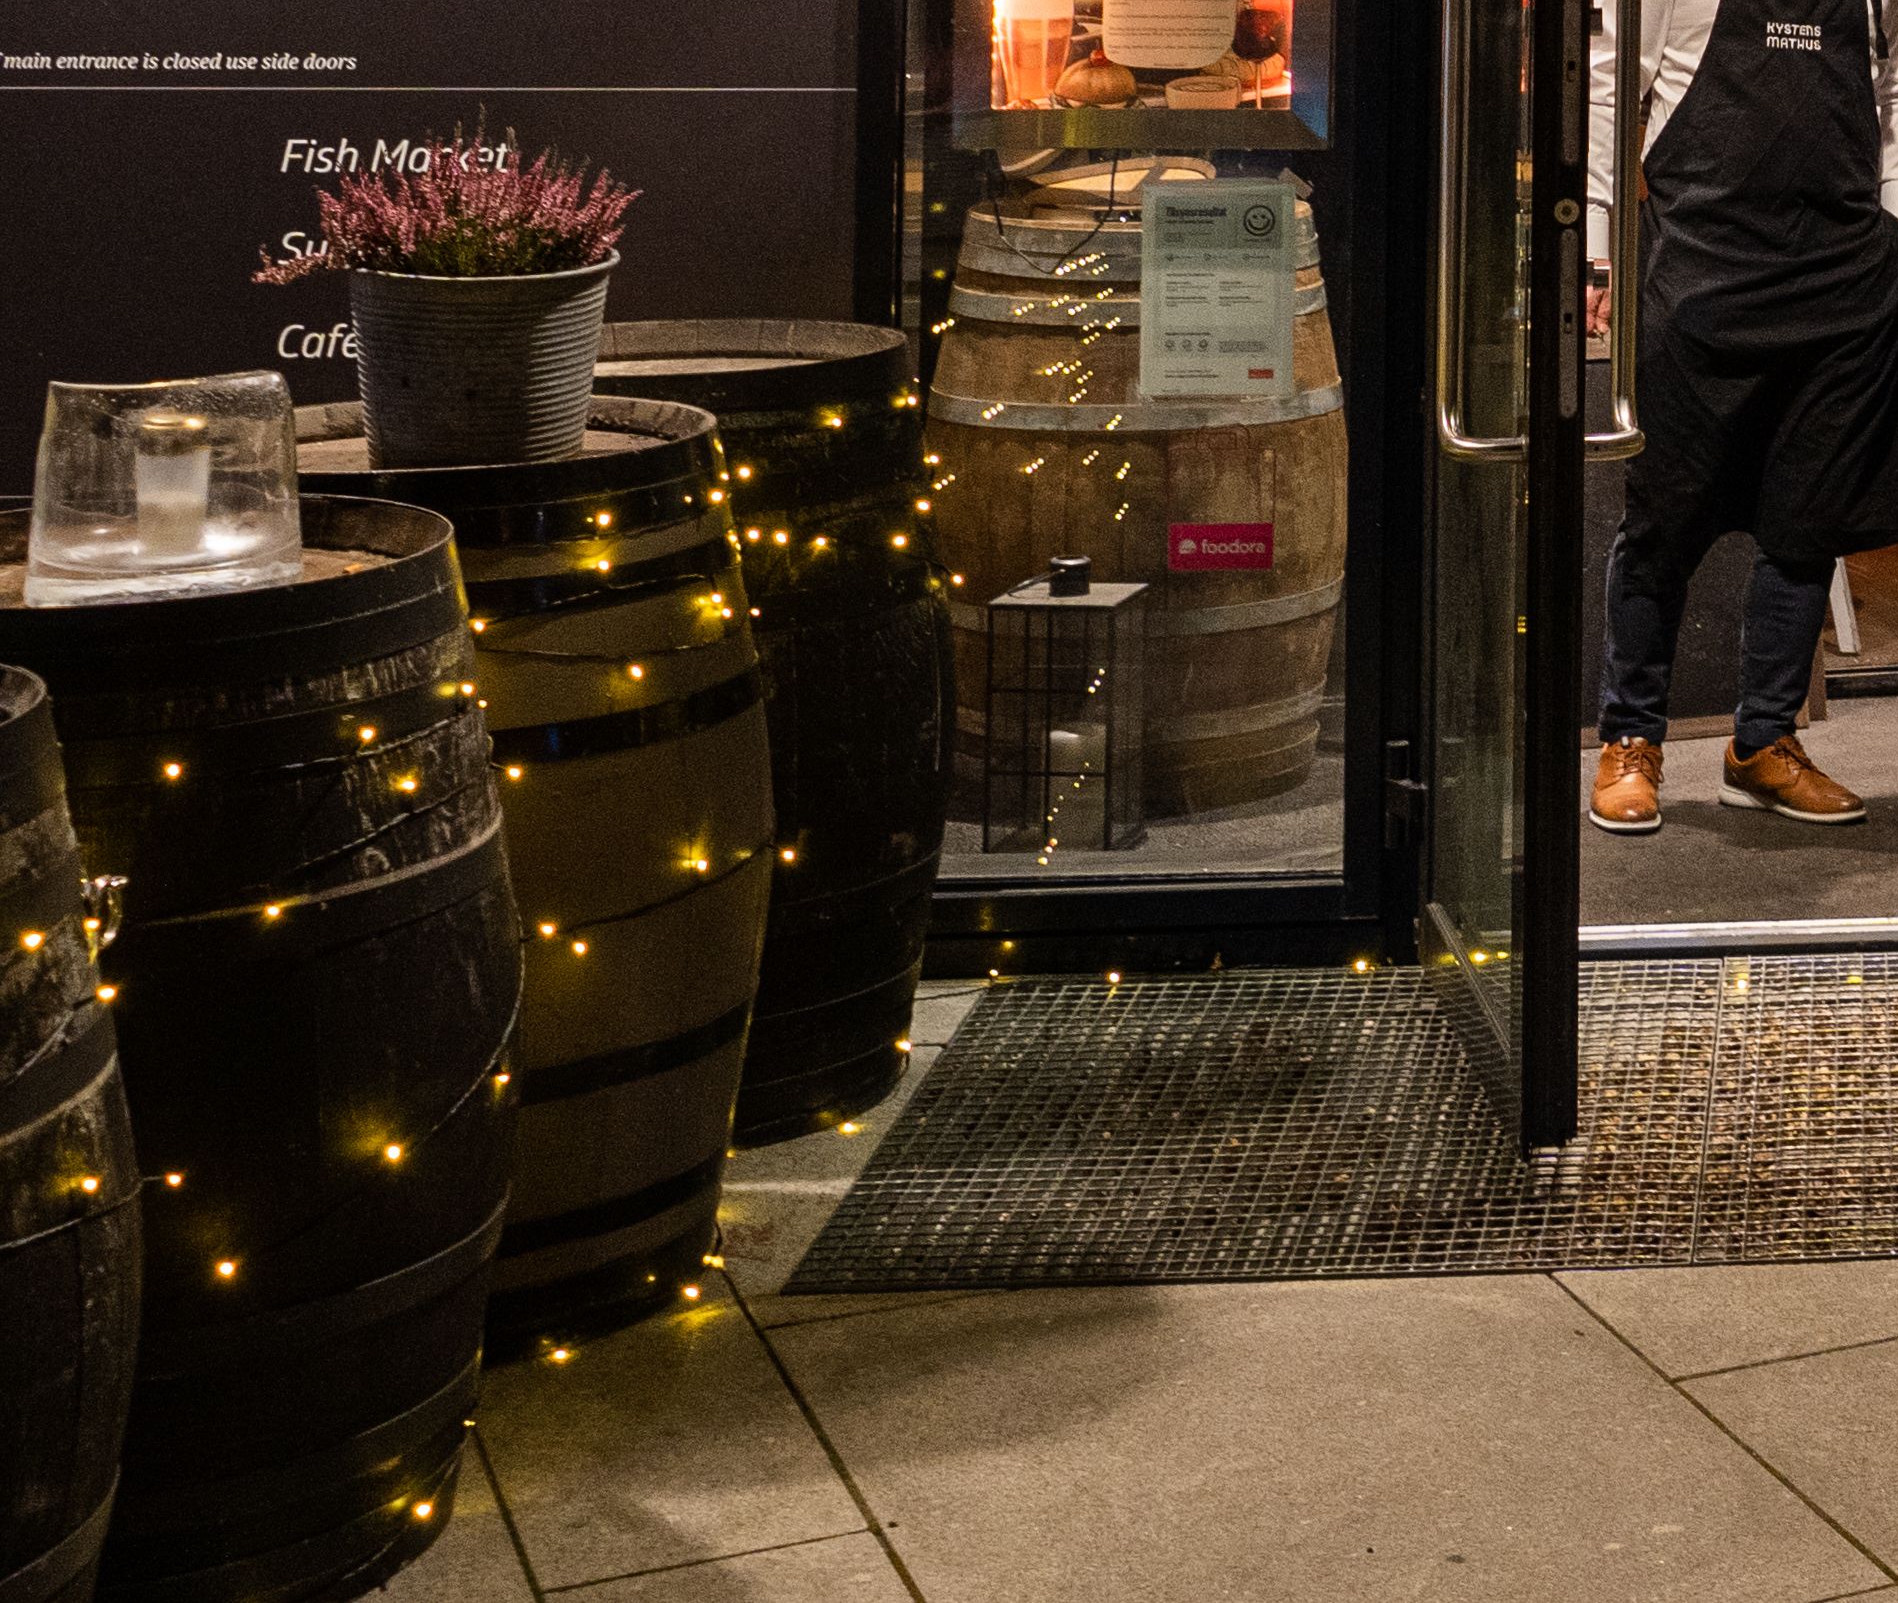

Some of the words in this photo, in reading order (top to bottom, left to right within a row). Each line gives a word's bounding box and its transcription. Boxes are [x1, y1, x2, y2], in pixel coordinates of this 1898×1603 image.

[1766, 21, 1822, 38] KYSTENS
[1766, 36, 1822, 51] MATHUS
[3, 52, 52, 70] main
[56, 53, 139, 70] entrance
[143, 52, 159, 70] is
[163, 52, 222, 70] closed
[226, 55, 258, 70] use
[261, 52, 299, 70] side
[303, 52, 357, 71] doors
[280, 138, 359, 173] Fish
[371, 139, 508, 173] Maket
[1201, 539, 1266, 555] foodora
